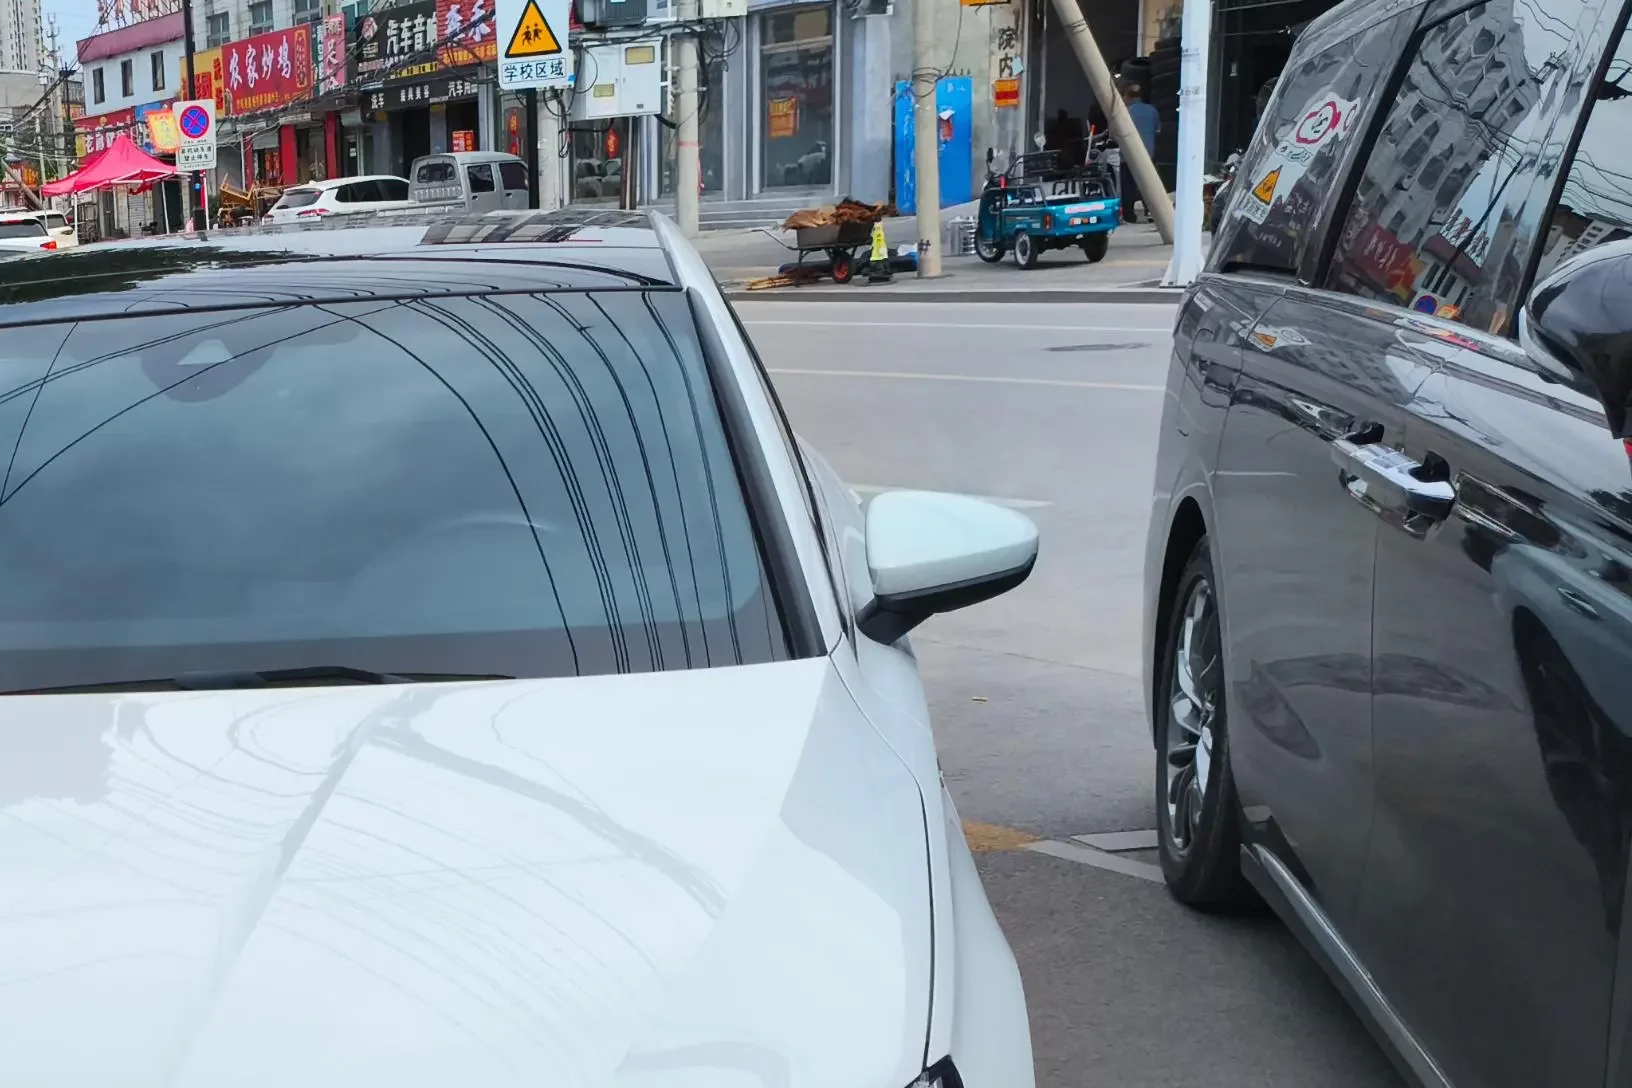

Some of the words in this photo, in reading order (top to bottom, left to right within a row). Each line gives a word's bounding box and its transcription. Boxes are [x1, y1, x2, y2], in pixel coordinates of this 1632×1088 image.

[229, 35, 292, 91] 农家炒鸡
[504, 60, 565, 82] 学校区域
